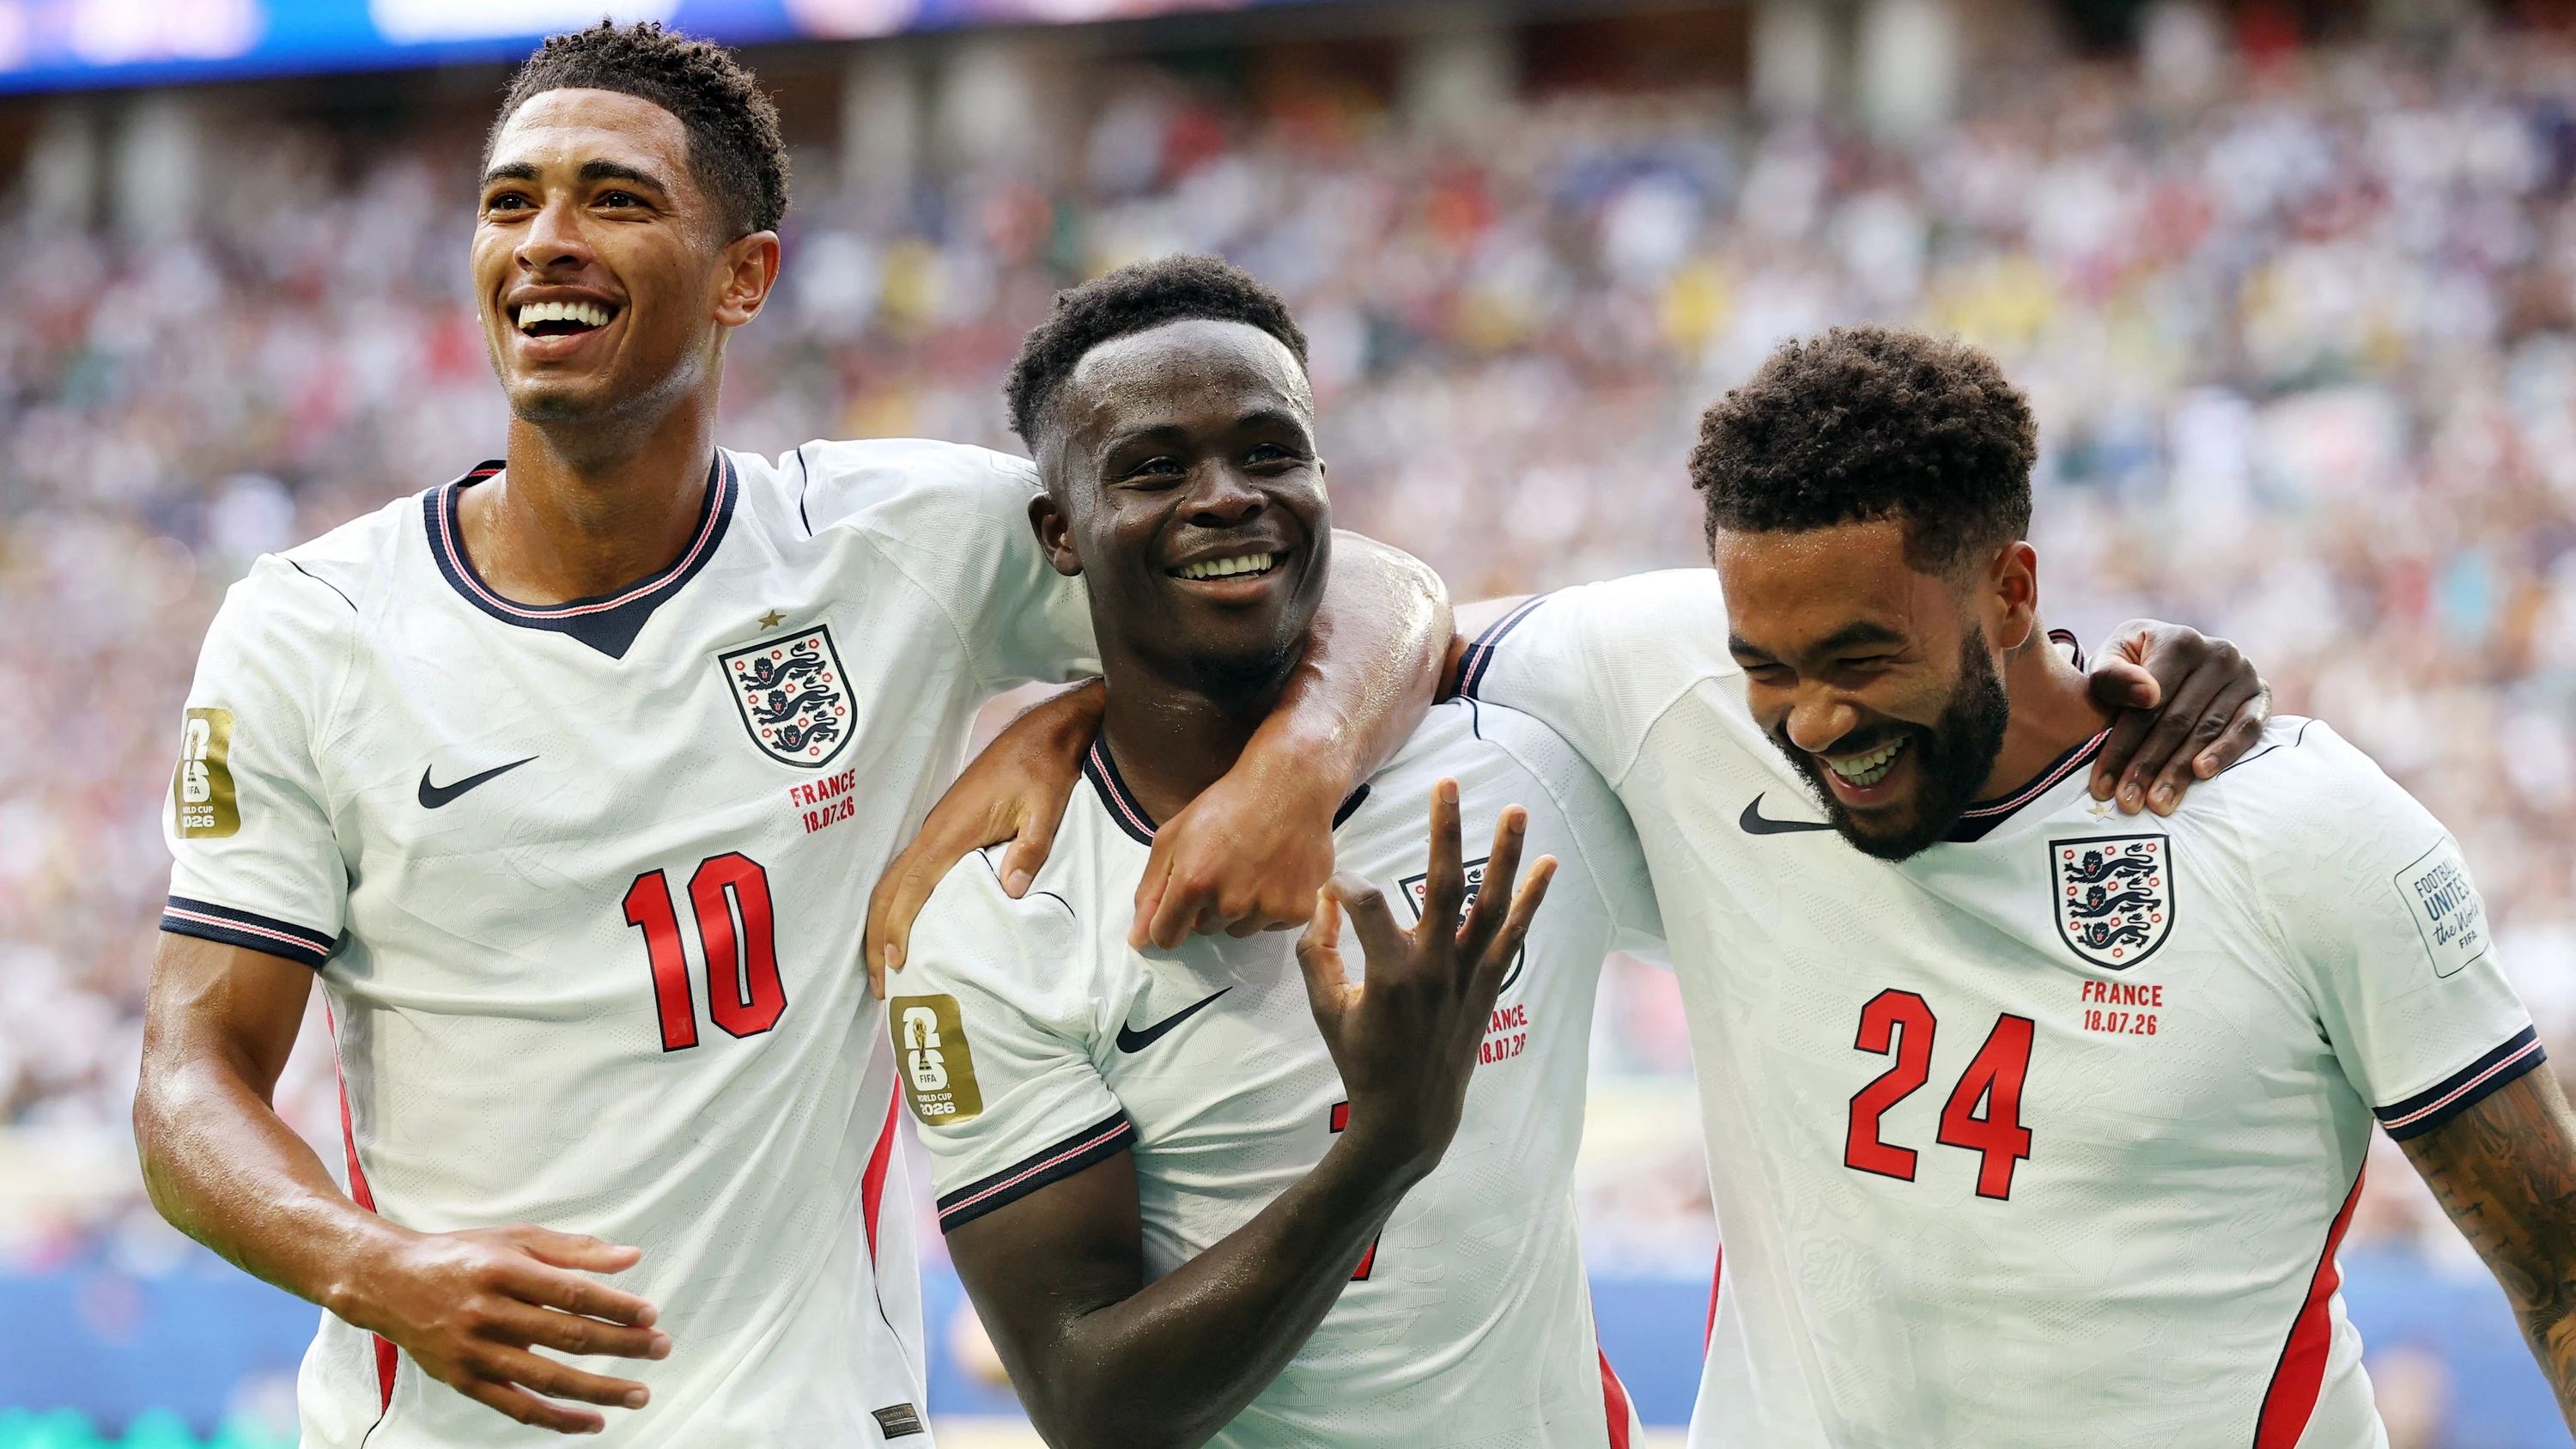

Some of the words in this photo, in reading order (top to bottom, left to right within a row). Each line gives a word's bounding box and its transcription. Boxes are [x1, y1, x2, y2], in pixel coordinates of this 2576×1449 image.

[790, 768, 856, 808] FRANCE
[183, 815, 215, 828] 026
[197, 805, 213, 813] CUP
[803, 795, 855, 834] 18.07.26
[2414, 856, 2458, 898] FOOTBALL
[2424, 873, 2470, 922] UNITES
[2433, 922, 2457, 947] the
[2458, 930, 2478, 949] FIFA
[622, 850, 788, 1053] 10
[2081, 981, 2163, 1007] FRANCE
[1486, 1004, 1528, 1034] ANCE
[2084, 1009, 2157, 1036] 18.07.26
[920, 1074, 937, 1083] FIFA
[937, 1093, 953, 1101] CUP
[1844, 988, 2035, 1201] 24
